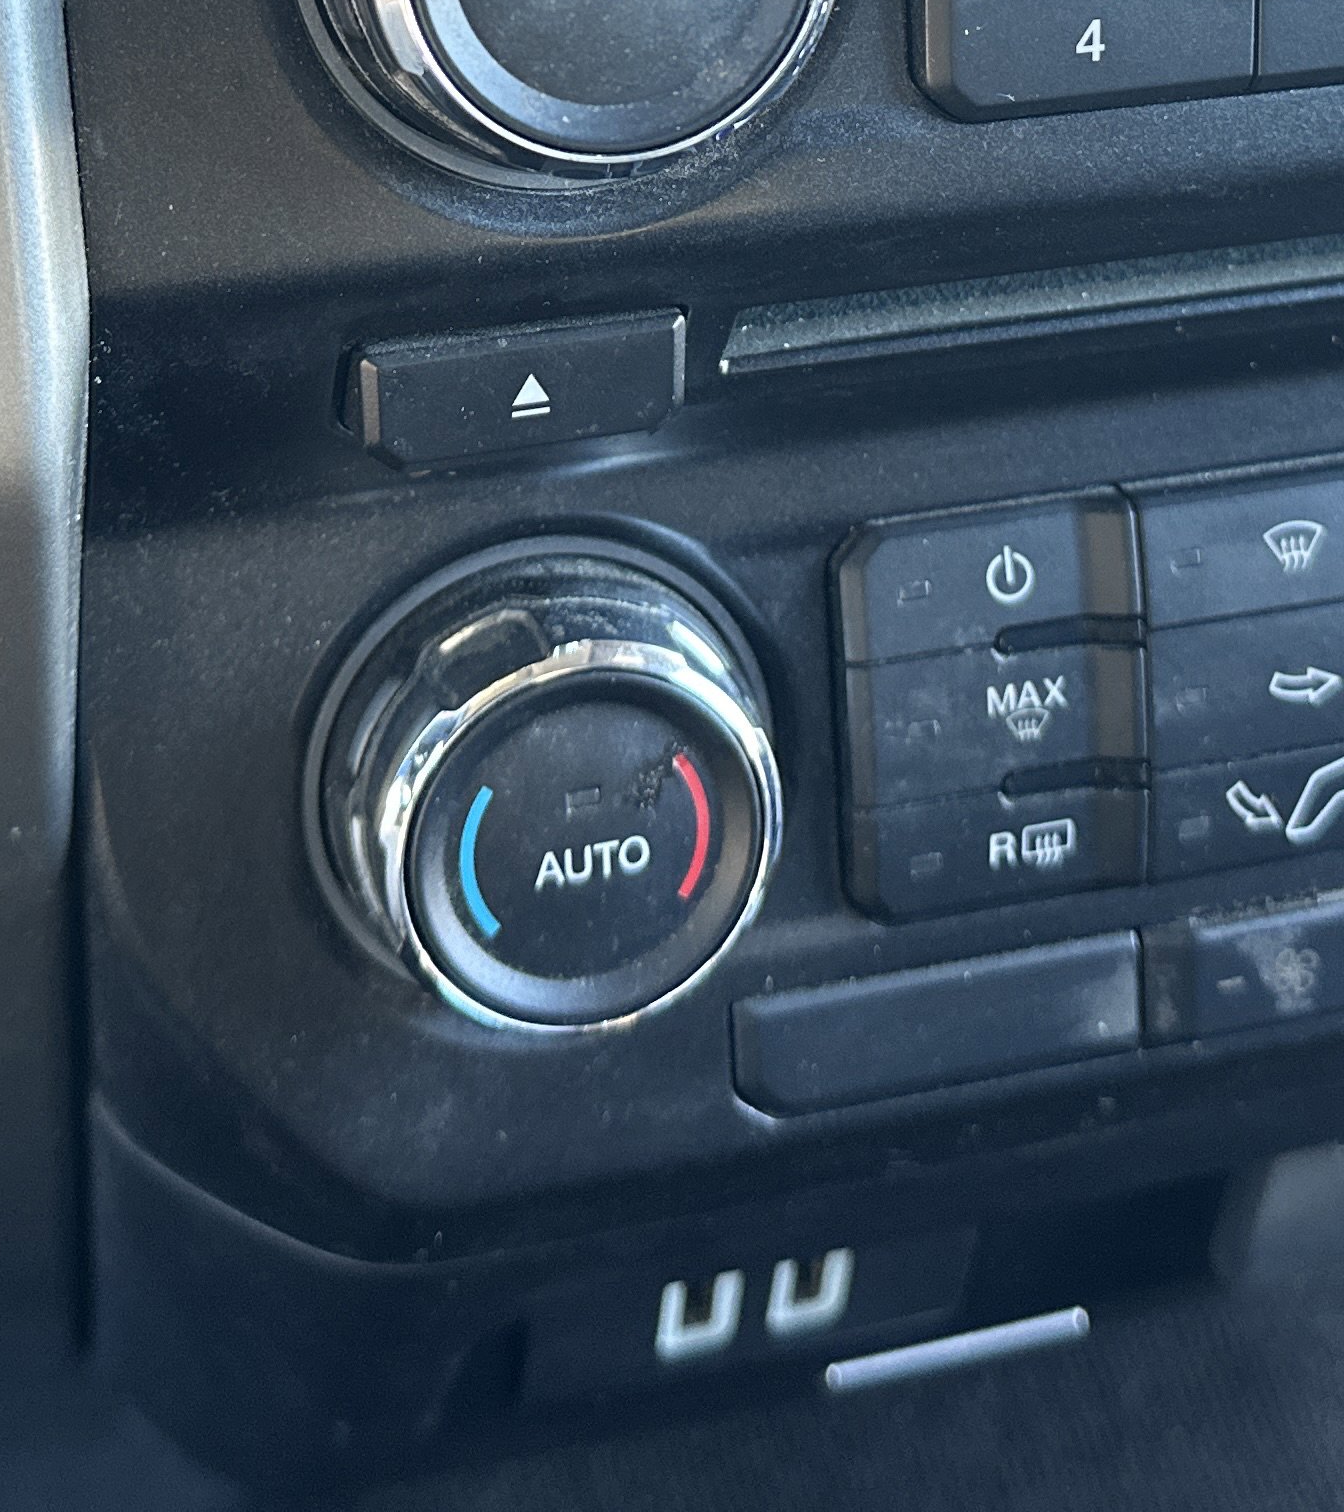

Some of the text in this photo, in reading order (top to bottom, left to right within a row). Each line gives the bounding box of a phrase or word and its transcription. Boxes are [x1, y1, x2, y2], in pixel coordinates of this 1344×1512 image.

[1074, 19, 1107, 63] 4
[986, 674, 1069, 720] MAX
[534, 834, 652, 890] AUTO
[989, 830, 1018, 871] R
